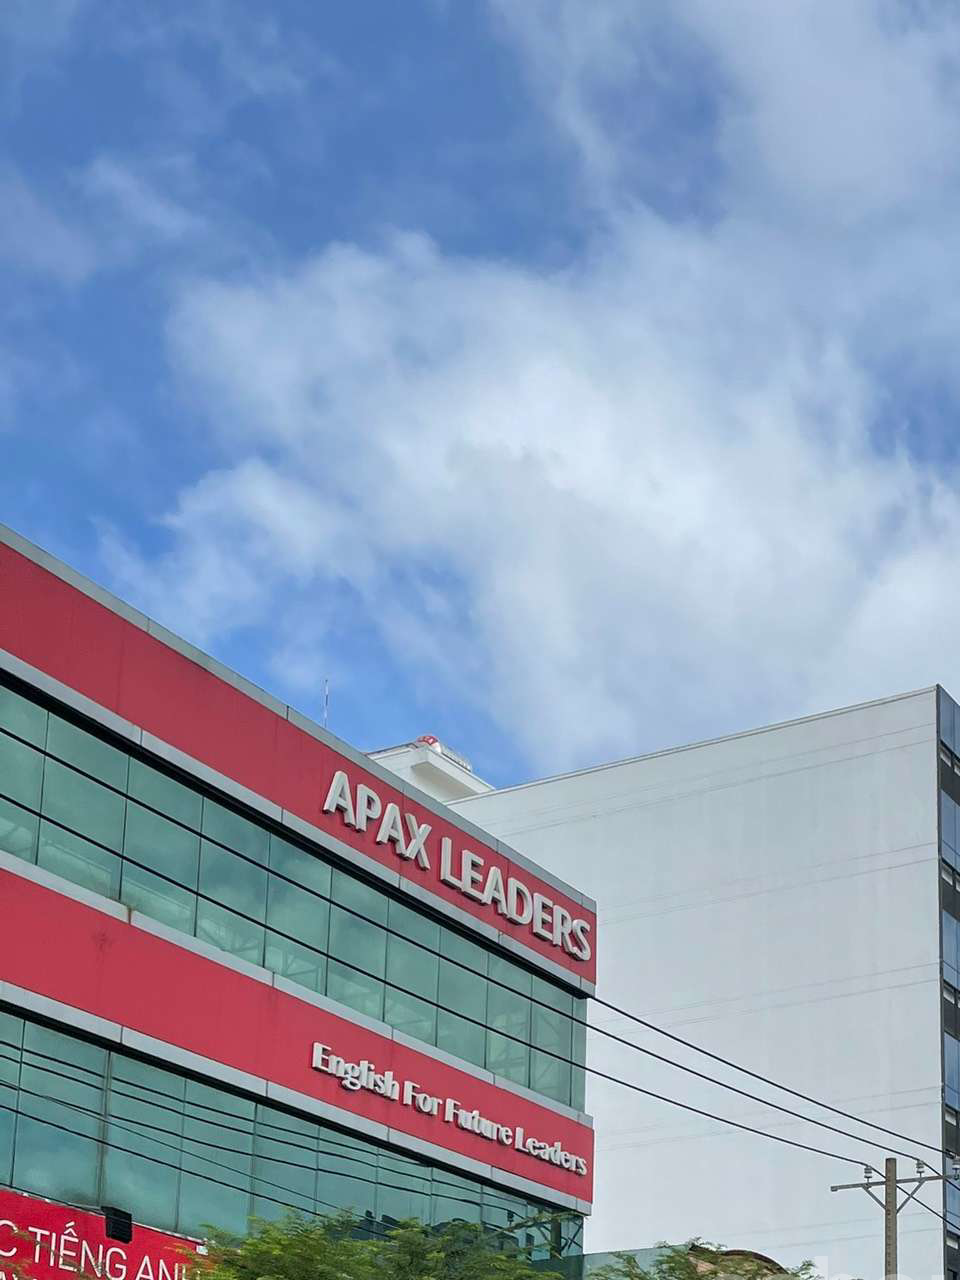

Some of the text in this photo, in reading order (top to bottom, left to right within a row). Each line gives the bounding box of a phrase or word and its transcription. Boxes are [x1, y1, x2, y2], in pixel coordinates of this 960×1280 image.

[322, 770, 591, 961] APAX LEADERS
[312, 1041, 587, 1176] English For Future Leaders
